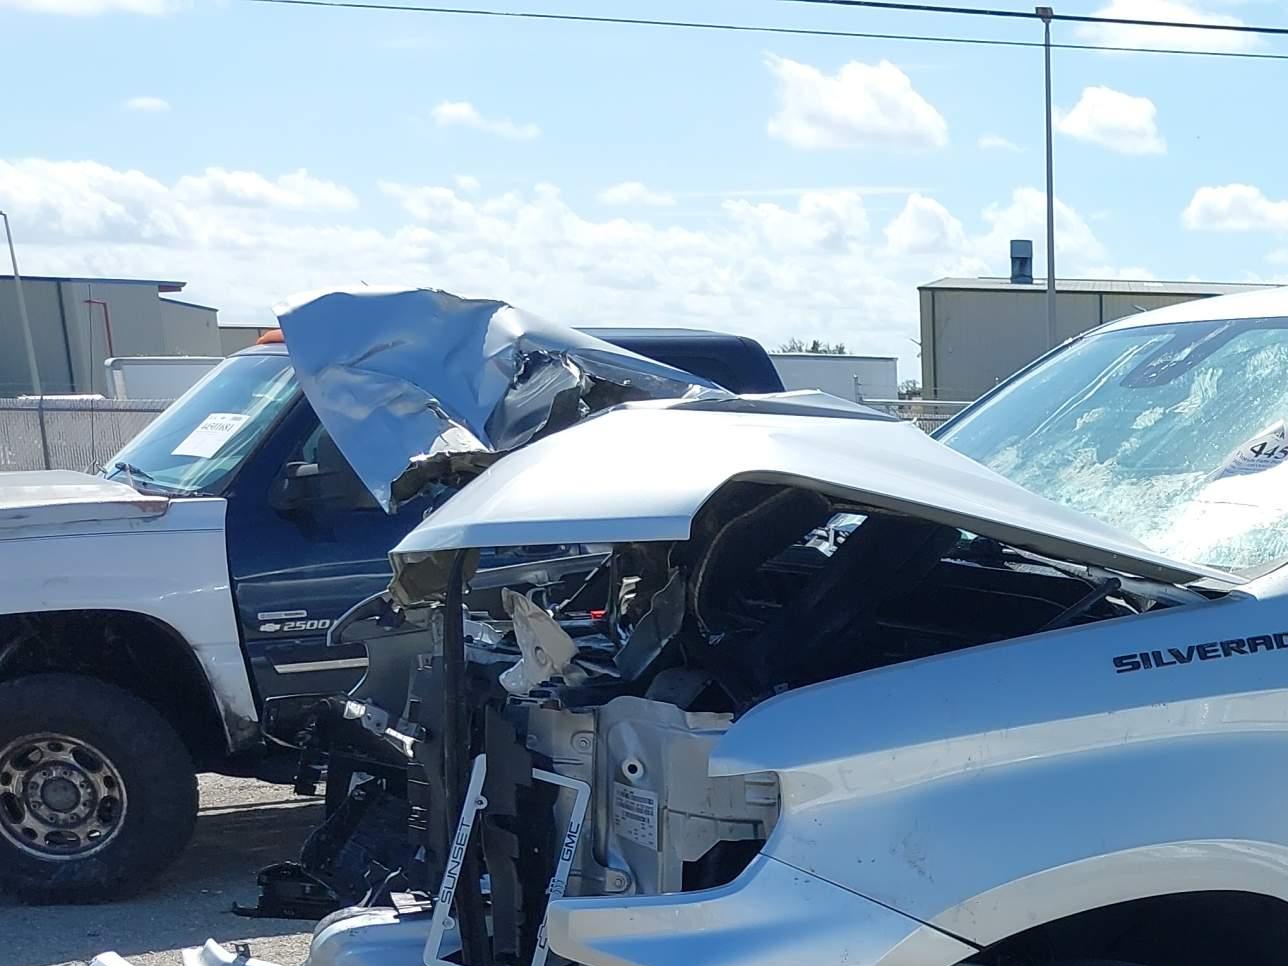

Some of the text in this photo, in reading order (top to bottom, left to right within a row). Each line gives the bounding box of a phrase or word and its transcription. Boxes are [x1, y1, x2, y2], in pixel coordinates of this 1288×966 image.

[283, 619, 331, 632] 2500
[440, 816, 472, 905] SUNSET
[561, 821, 581, 863] GMC
